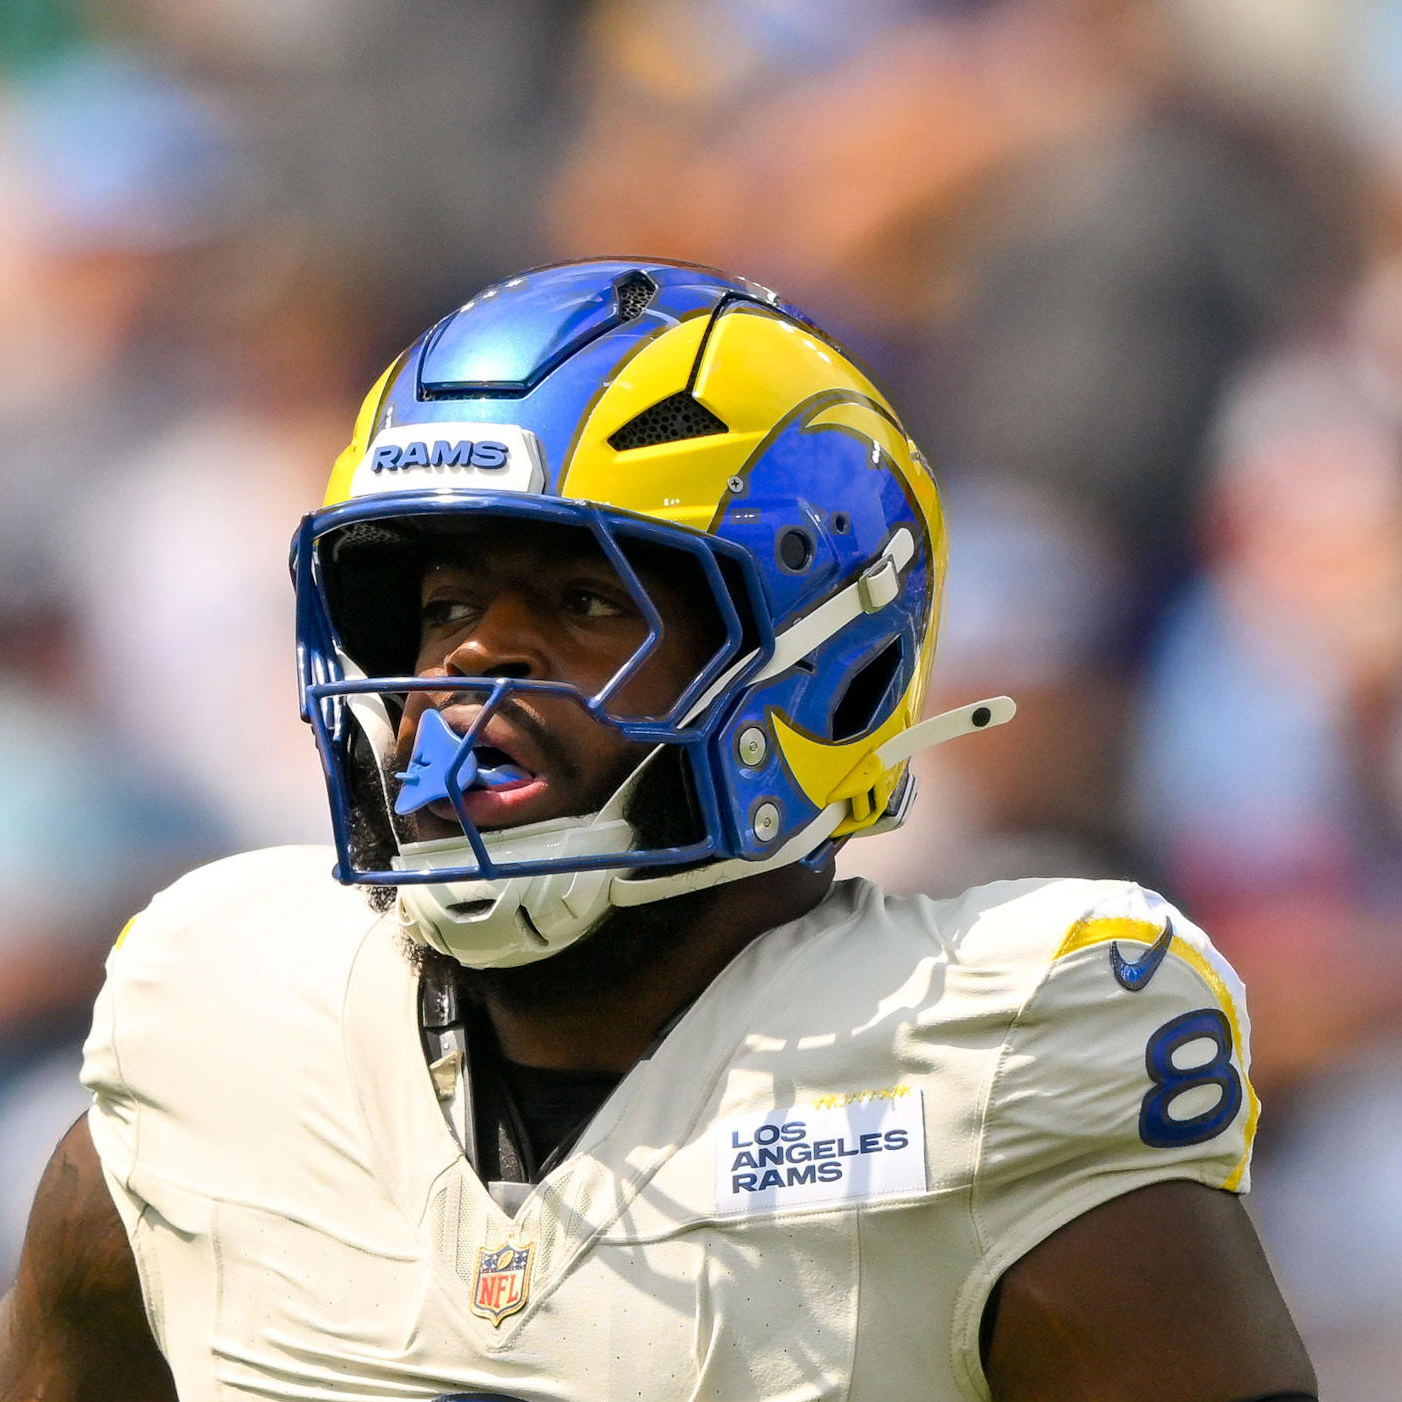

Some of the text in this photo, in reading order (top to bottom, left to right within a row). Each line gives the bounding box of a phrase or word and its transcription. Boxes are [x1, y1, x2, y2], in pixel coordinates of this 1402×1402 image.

[371, 440, 509, 473] RAMS
[1138, 1008, 1242, 1148] 8
[731, 1121, 806, 1149] LOS
[731, 1129, 909, 1171] ANGELES
[732, 1161, 843, 1194] RAMS
[478, 1274, 518, 1309] NFL
